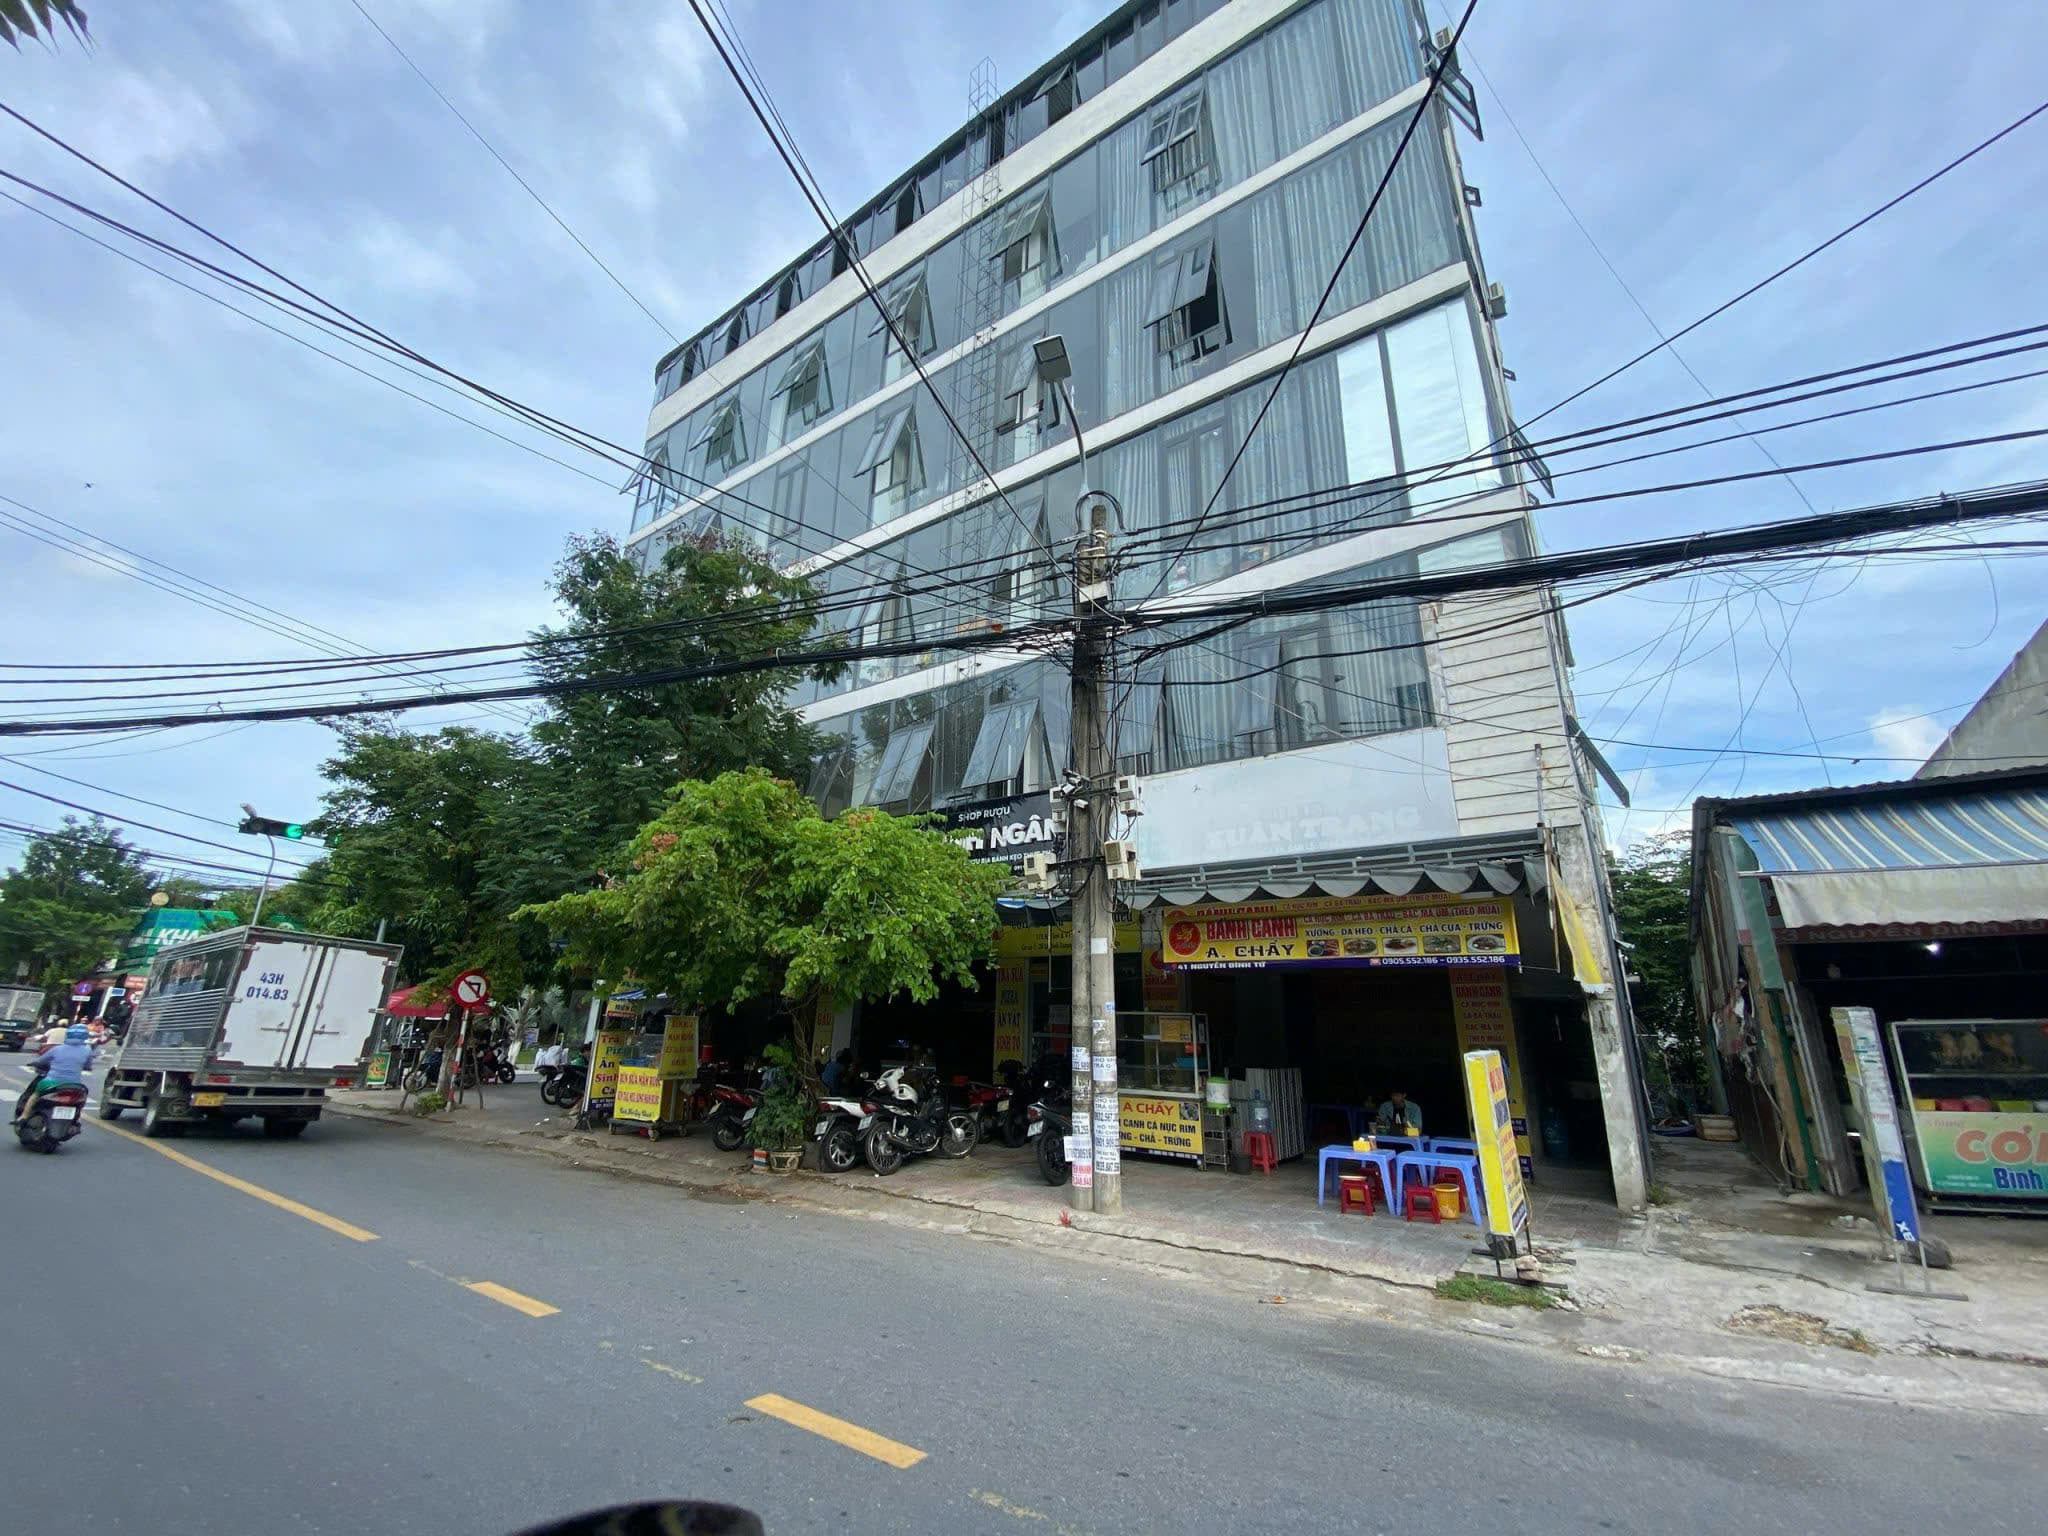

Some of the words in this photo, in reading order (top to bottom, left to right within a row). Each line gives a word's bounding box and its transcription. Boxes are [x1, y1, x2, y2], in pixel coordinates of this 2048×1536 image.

[958, 811, 982, 822] SHOP
[1206, 917, 1248, 941] BÁNH
[1250, 917, 1296, 938] CANH
[1341, 927, 1352, 935] DA
[1355, 926, 1373, 935] HEO
[1441, 923, 1461, 932] CUA
[1382, 955, 1438, 965] 0905.552.186
[1446, 955, 1505, 964] 0935.552.186
[260, 972, 284, 985] 43H
[246, 986, 288, 1001] 014.83
[1123, 1118, 1144, 1129] CANH
[1179, 1124, 1196, 1134] RIM
